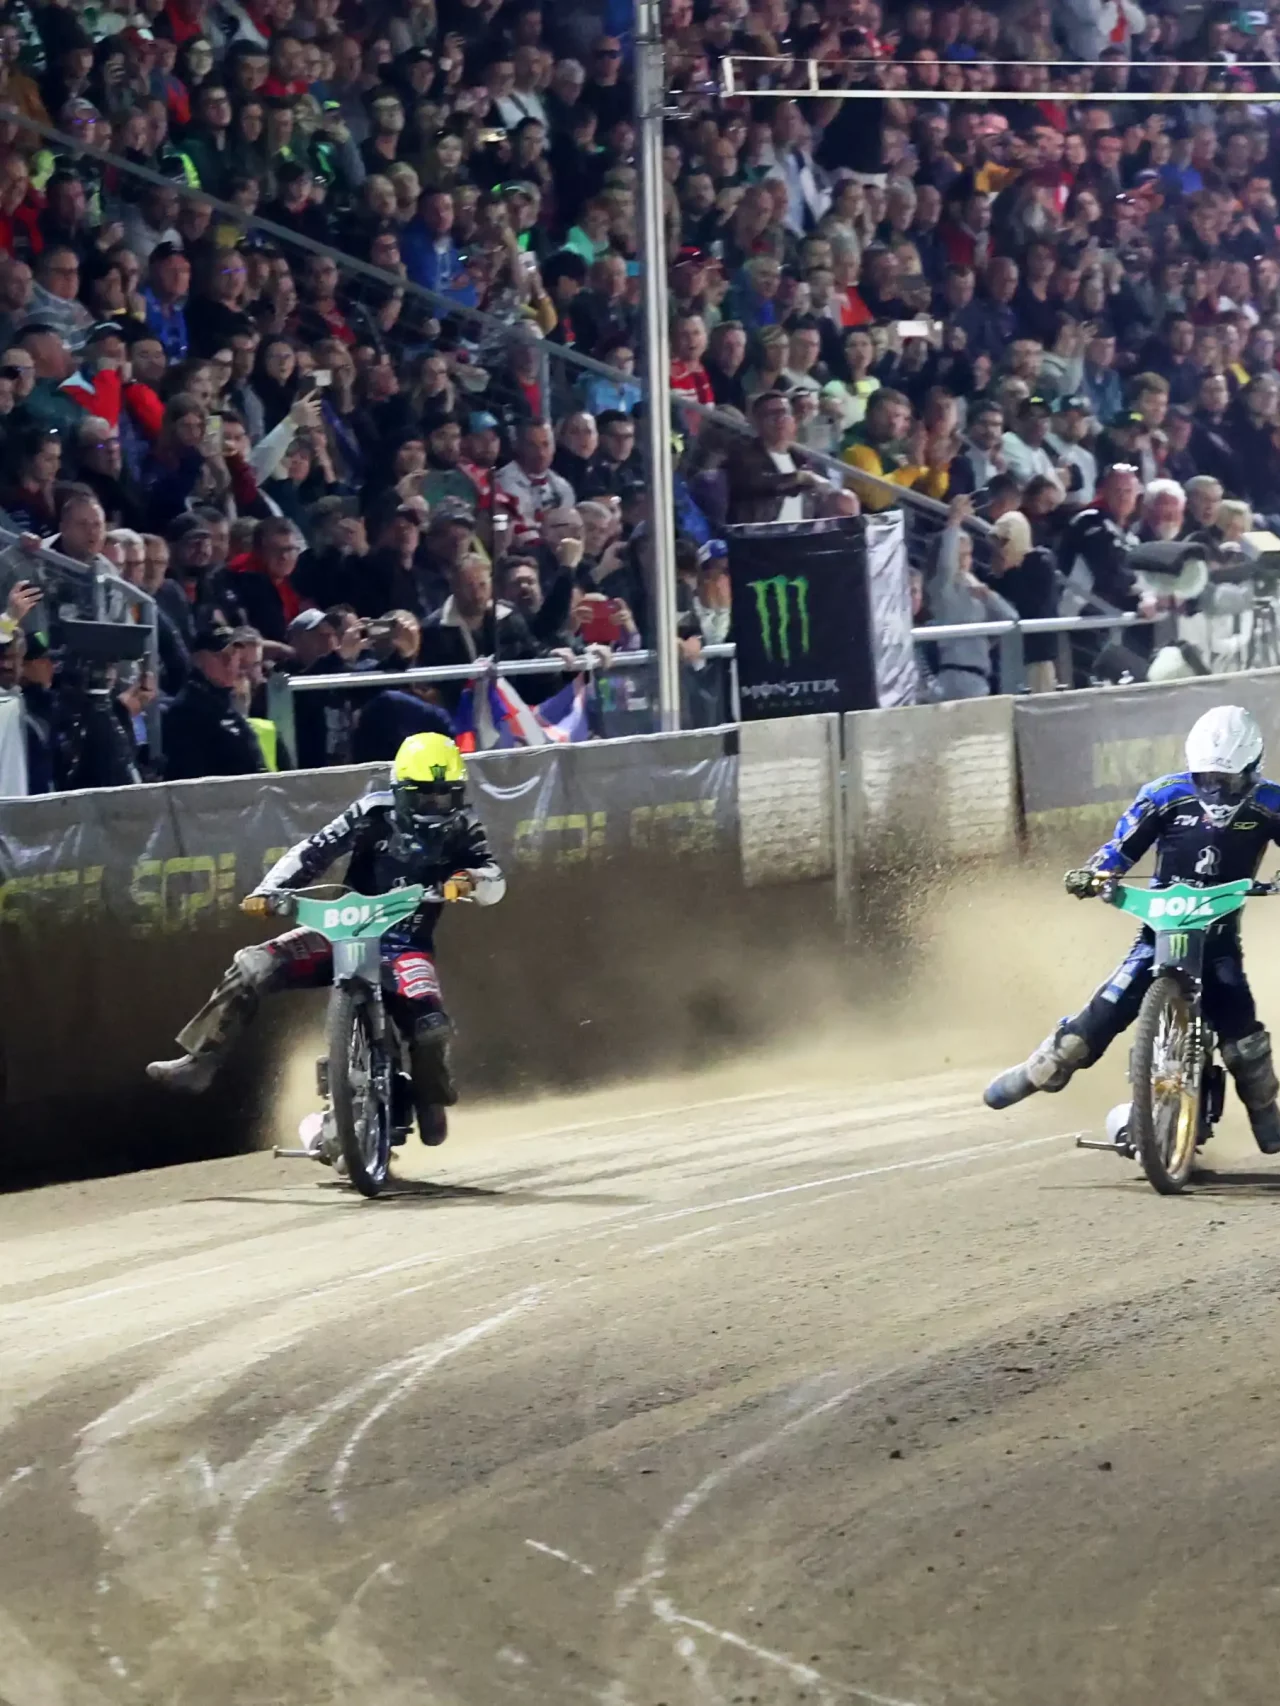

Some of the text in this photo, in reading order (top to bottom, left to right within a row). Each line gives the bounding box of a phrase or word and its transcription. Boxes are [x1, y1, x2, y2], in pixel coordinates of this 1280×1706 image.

[741, 679, 840, 699] MONSTER
[323, 904, 389, 929] BOLL
[1148, 896, 1214, 918] BOLL
